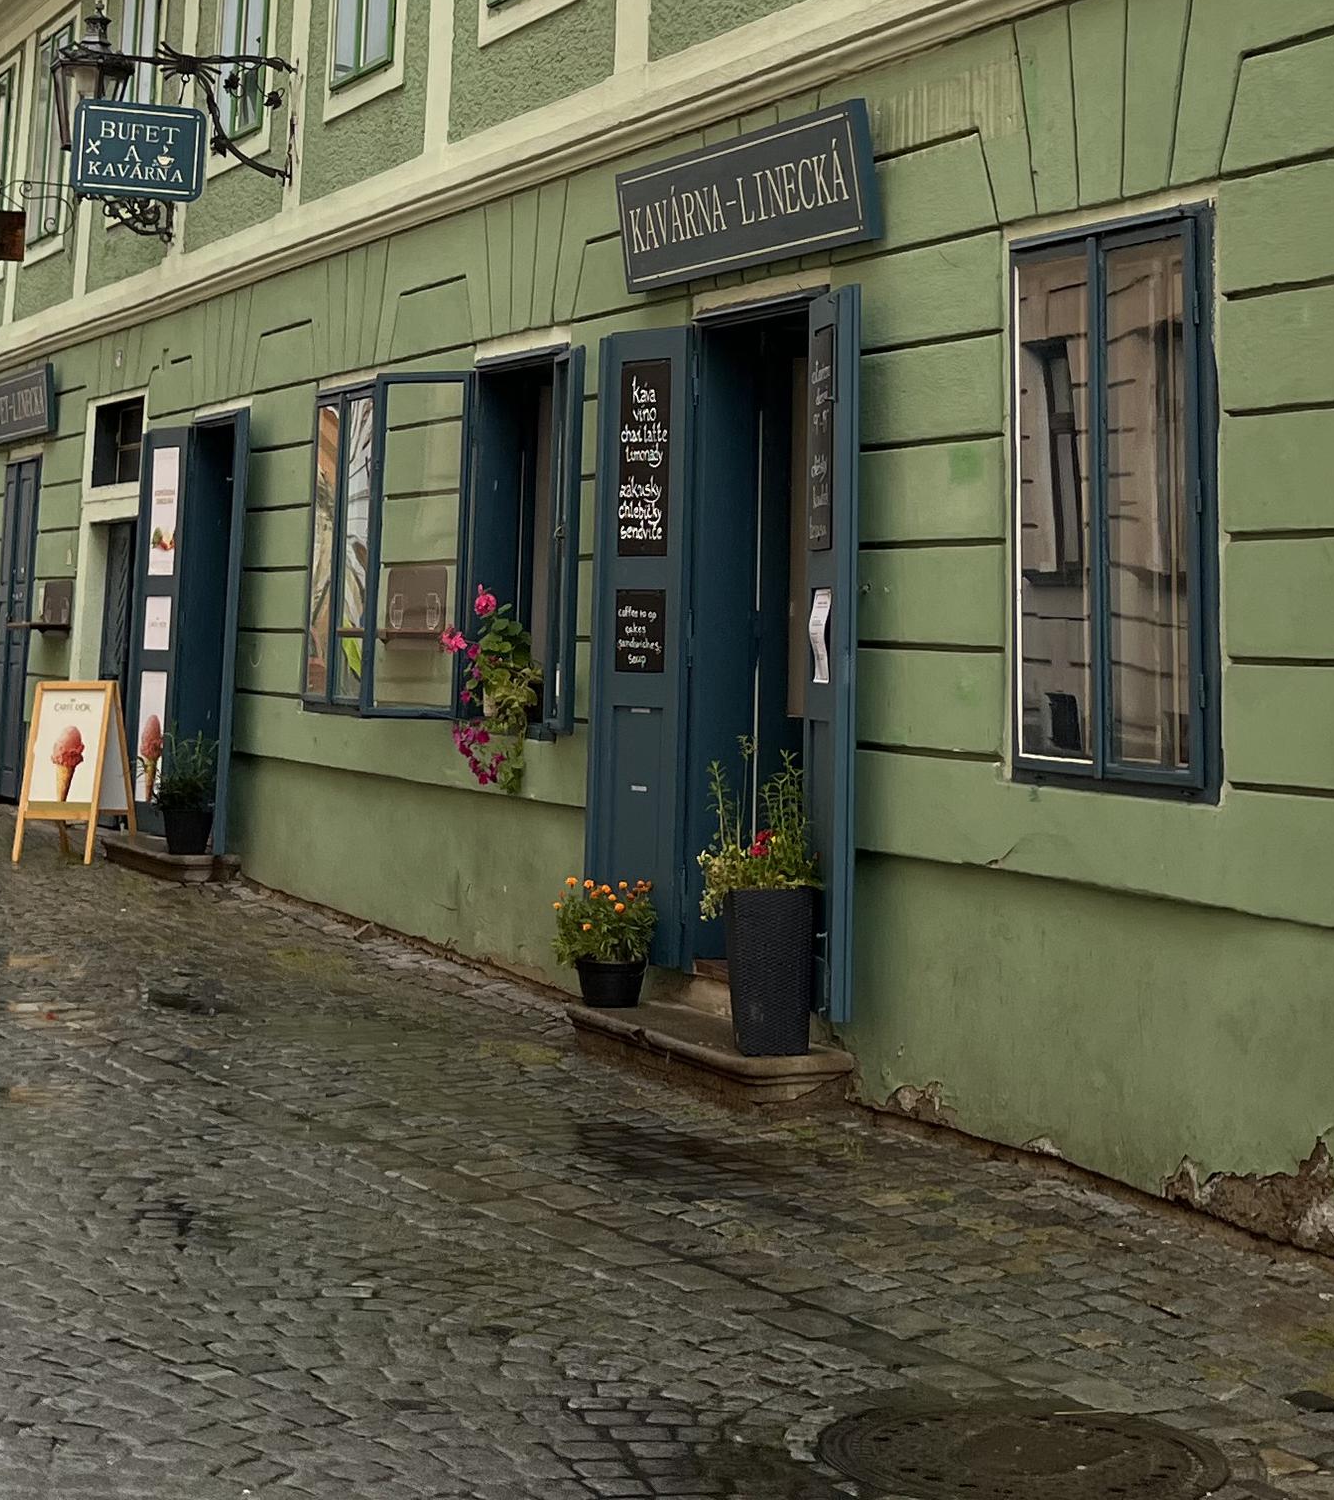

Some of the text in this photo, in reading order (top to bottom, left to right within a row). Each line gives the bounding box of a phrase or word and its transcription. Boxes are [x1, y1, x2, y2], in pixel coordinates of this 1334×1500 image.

[100, 120, 180, 145] BUFET
[124, 145, 142, 162] A
[87, 160, 184, 183] KAVÁRNA
[632, 404, 657, 422] víno
[621, 421, 668, 443] chai latte
[619, 475, 663, 503] zákusky
[627, 653, 647, 668] soup
